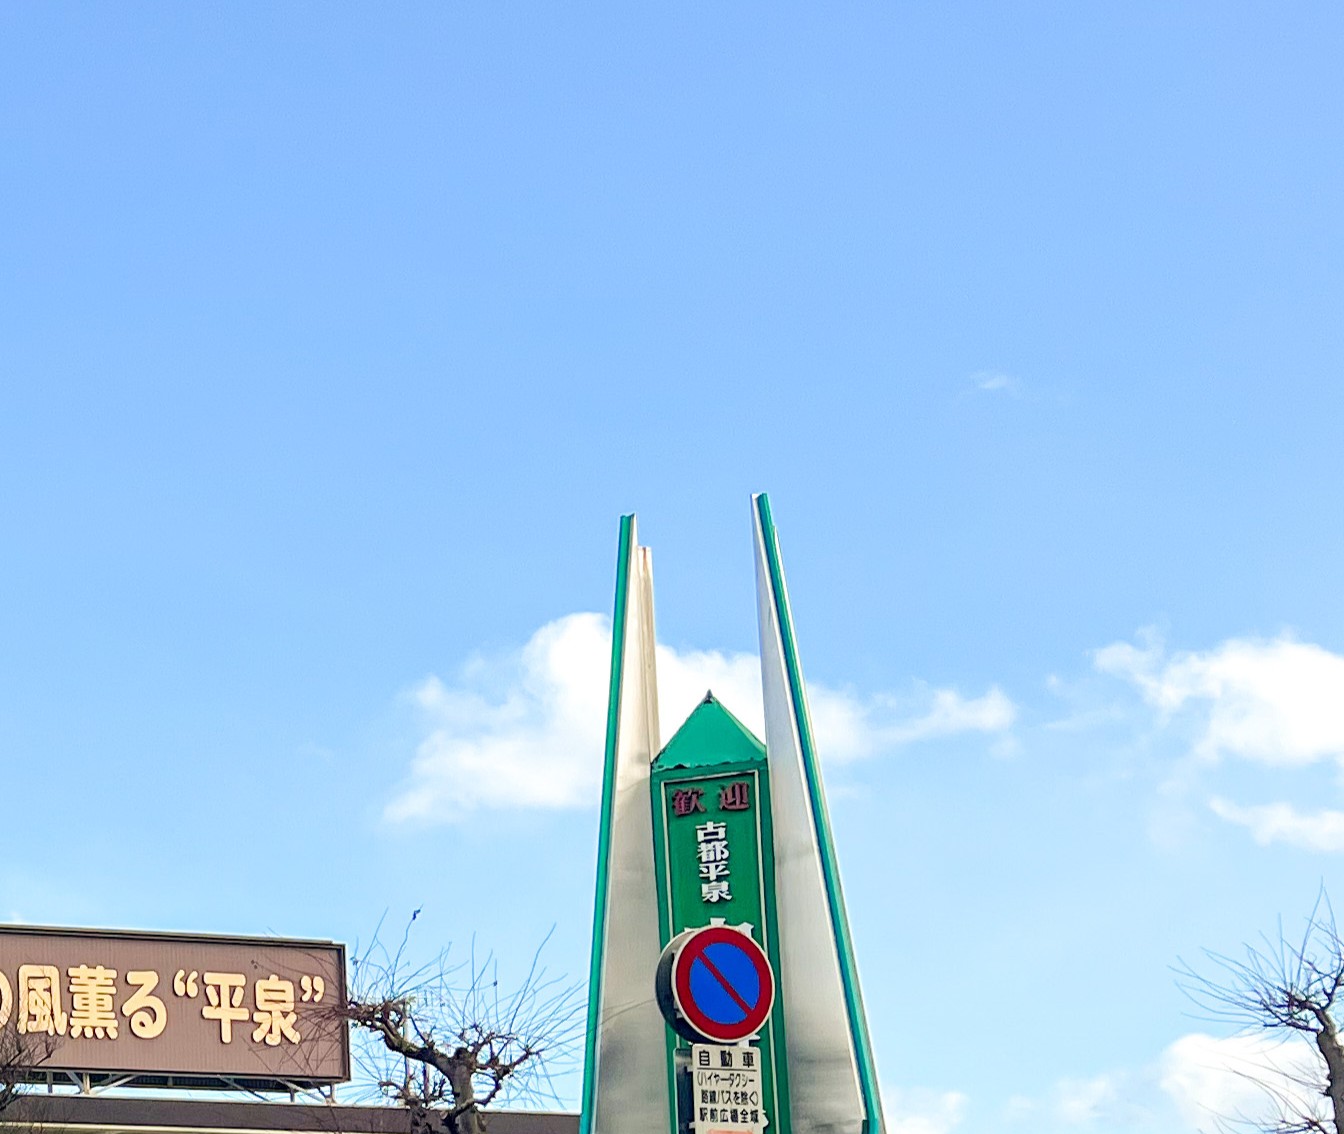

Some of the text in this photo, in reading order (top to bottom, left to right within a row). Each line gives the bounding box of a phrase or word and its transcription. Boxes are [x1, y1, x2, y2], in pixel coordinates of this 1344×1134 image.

[672, 781, 750, 816] 歓迎
[696, 821, 732, 903] 古都平泉
[699, 1049, 755, 1068] 自動車
[699, 1107, 759, 1124] 駅前広場全域
